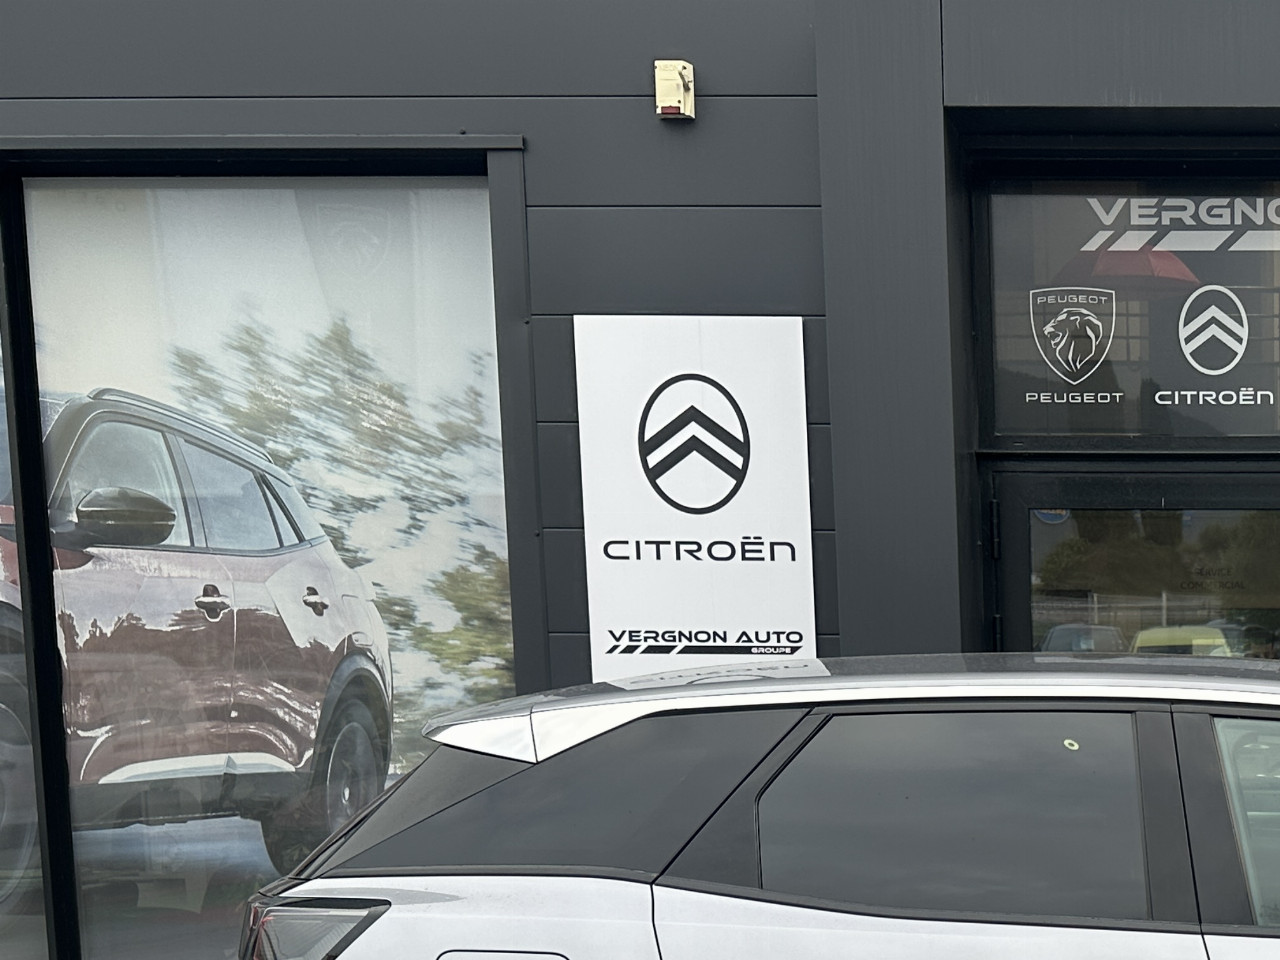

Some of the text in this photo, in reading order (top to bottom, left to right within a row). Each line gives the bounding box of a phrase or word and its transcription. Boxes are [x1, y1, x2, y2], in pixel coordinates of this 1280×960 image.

[1038, 295, 1107, 304] PEUGEOT
[1026, 393, 1123, 402] PEUGEOT
[608, 630, 803, 643] VERGNON AUTO
